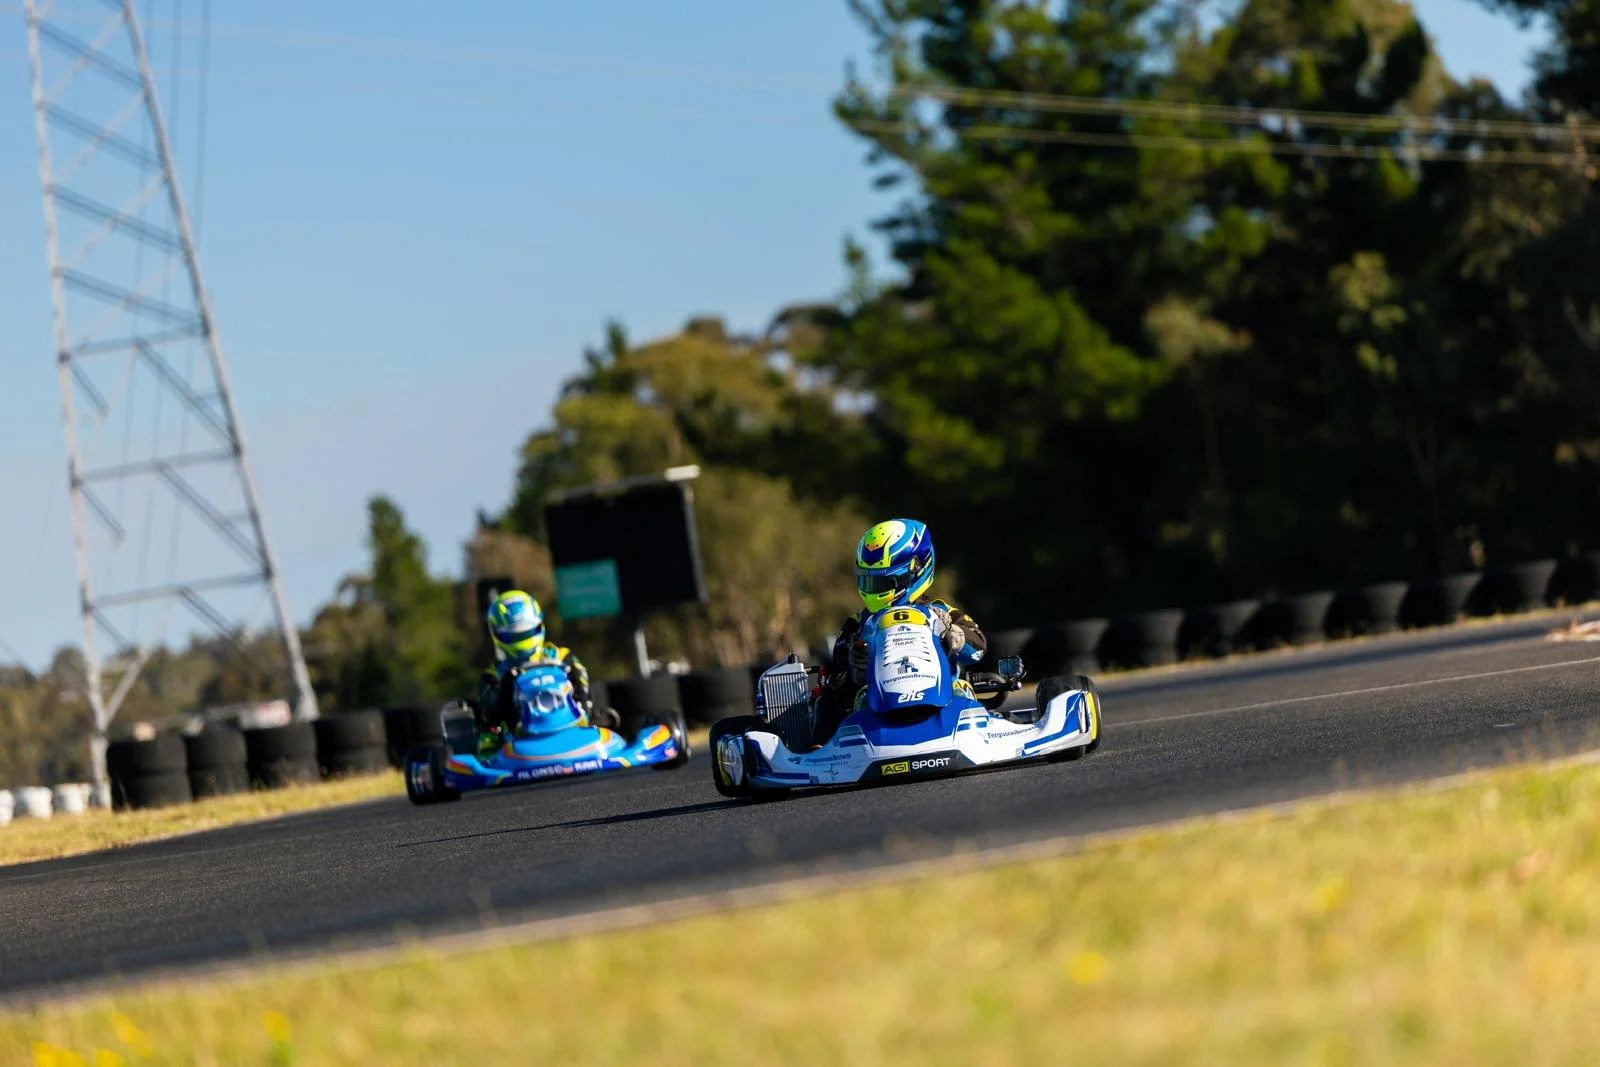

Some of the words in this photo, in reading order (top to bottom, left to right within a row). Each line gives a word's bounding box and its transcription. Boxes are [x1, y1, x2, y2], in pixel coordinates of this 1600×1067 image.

[893, 611, 909, 621] 6
[883, 763, 908, 775] AGI
[911, 757, 951, 770] SPORT
